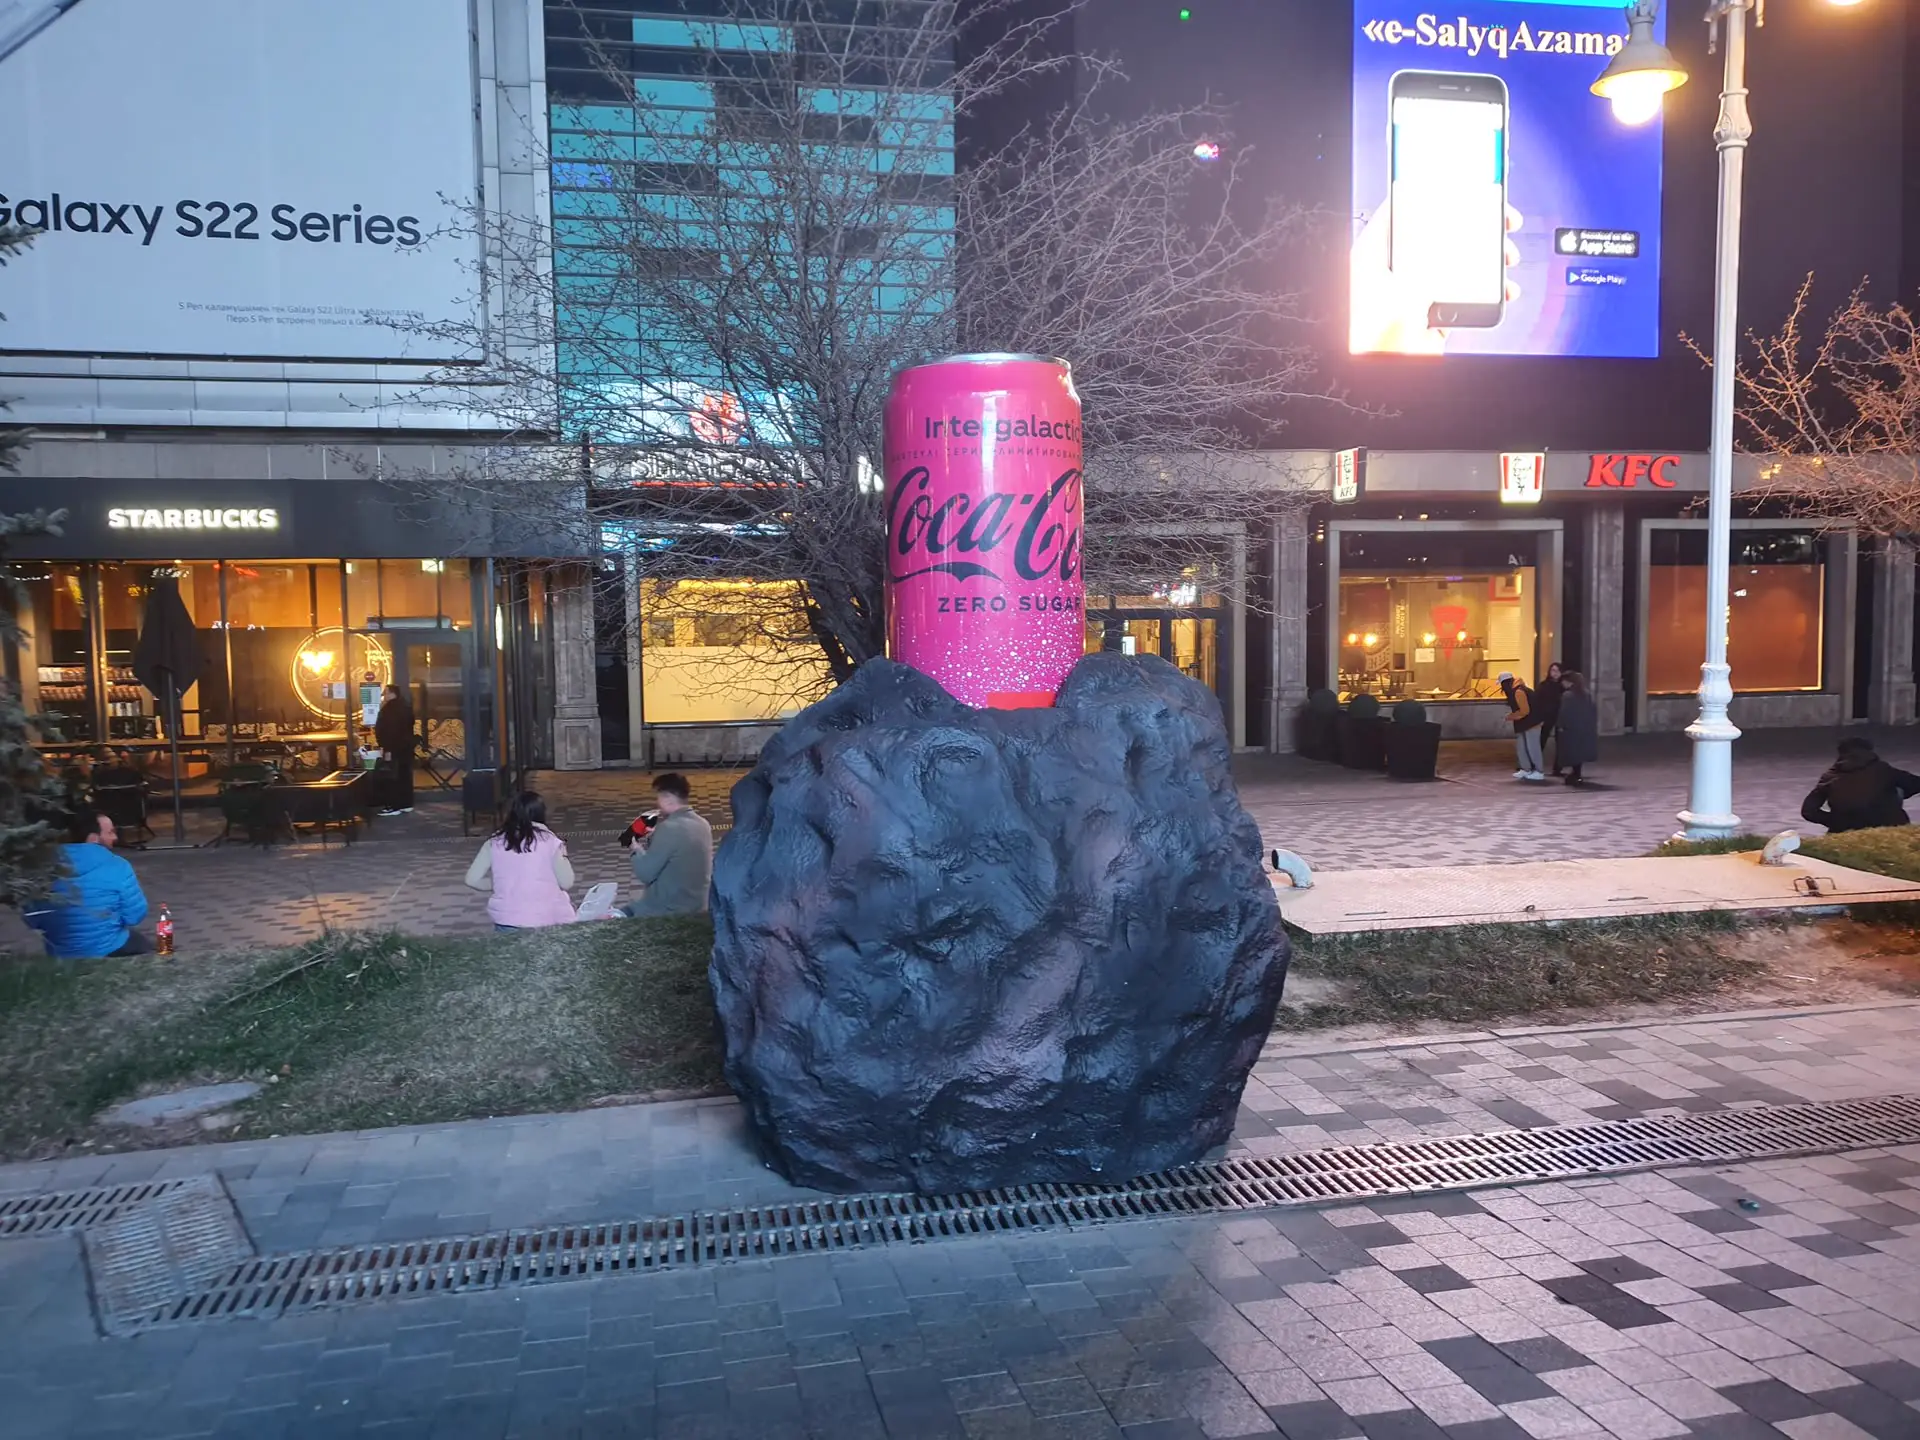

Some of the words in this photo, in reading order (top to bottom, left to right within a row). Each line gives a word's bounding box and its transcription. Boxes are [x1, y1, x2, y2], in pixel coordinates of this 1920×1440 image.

[1362, 13, 1632, 58] «e-SalyqAzama
[175, 200, 260, 240] S22
[271, 203, 421, 246] Series
[1579, 240, 1603, 255] App
[1603, 241, 1636, 255] Store
[1580, 274, 1606, 285] Google
[1606, 275, 1627, 286] Play
[178, 302, 185, 310] S
[287, 305, 316, 315] Galaxy
[317, 306, 333, 315] S22
[334, 306, 356, 315] Ultra
[226, 314, 250, 325] Перо
[1584, 454, 1682, 488] KFC
[1339, 486, 1355, 498] KFC
[108, 508, 280, 530] STARBUCKS
[937, 597, 1006, 613] ZERO
